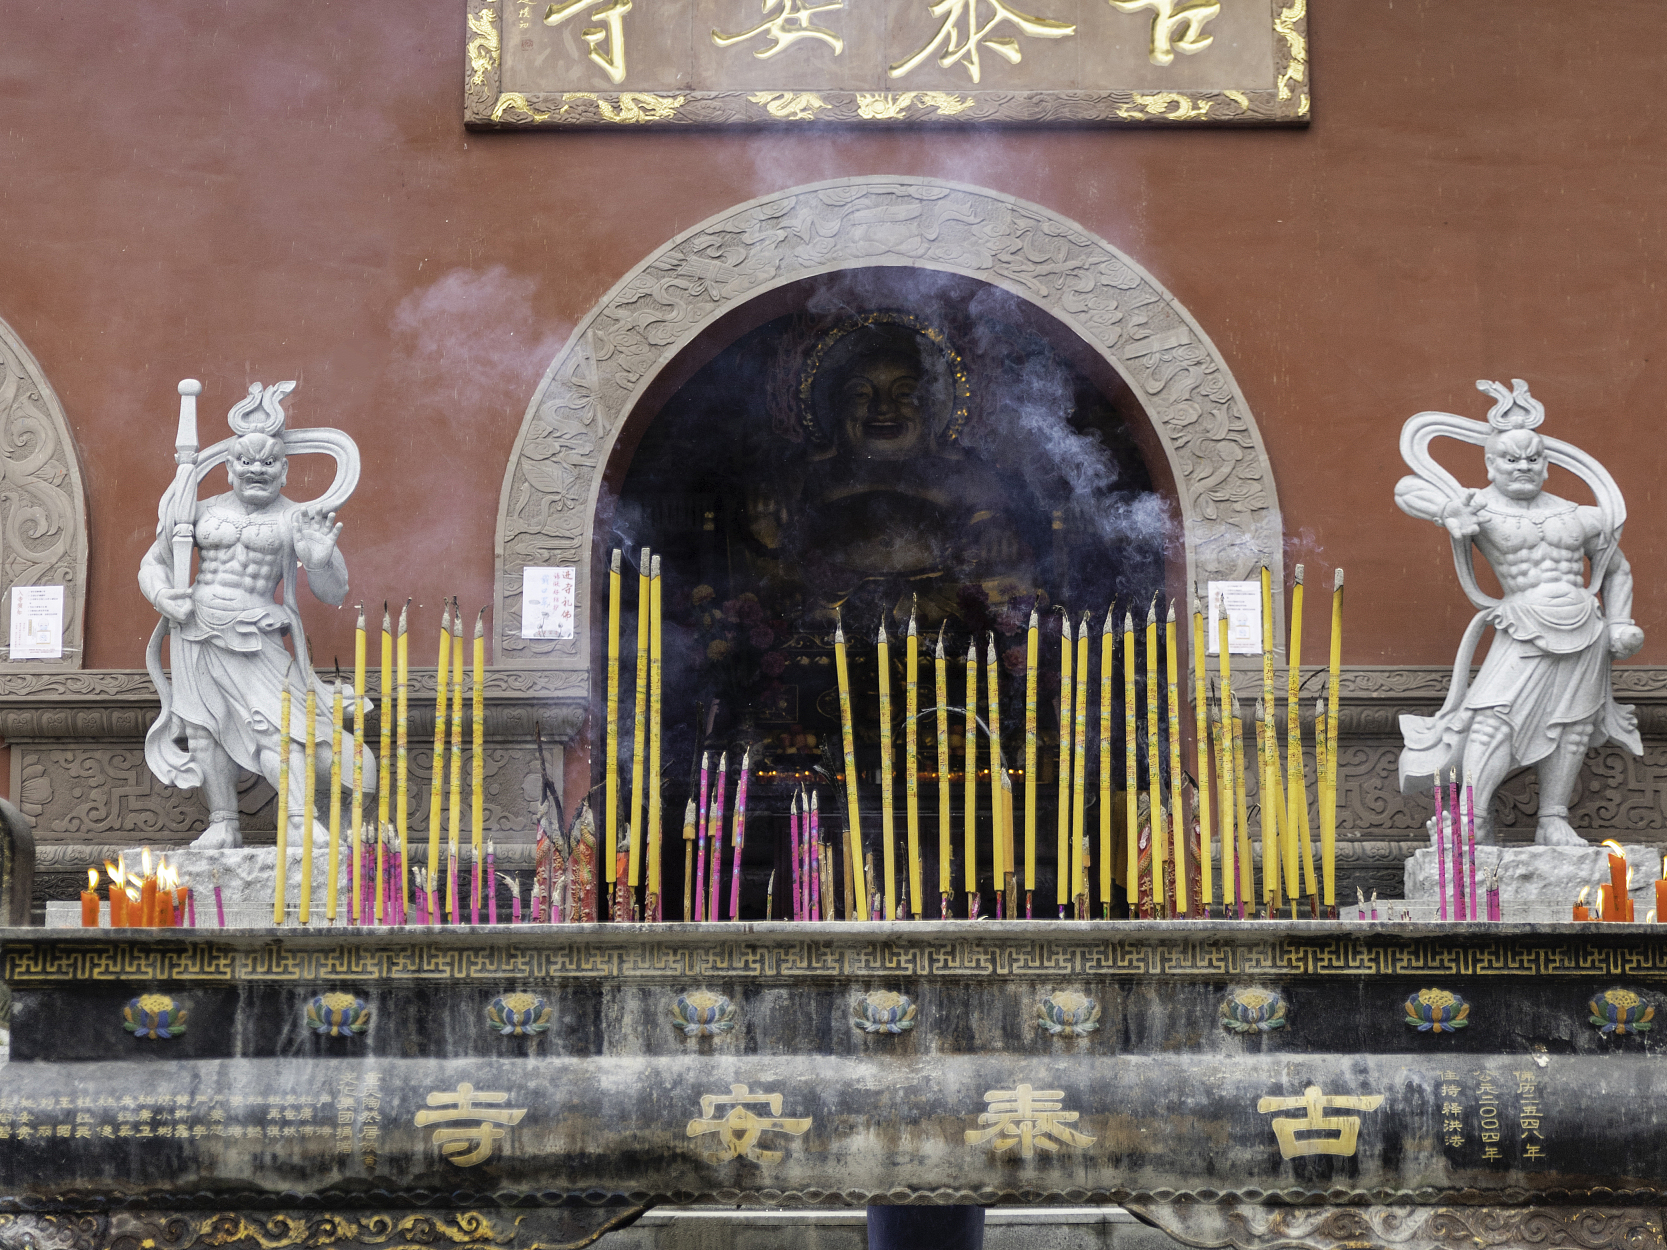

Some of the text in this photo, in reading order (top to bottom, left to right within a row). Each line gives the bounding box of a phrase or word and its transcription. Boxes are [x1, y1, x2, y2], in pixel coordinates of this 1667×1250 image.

[413, 1083, 1385, 1168] 古泰安寺
[1513, 1070, 1546, 1162] 佛历二五四八年
